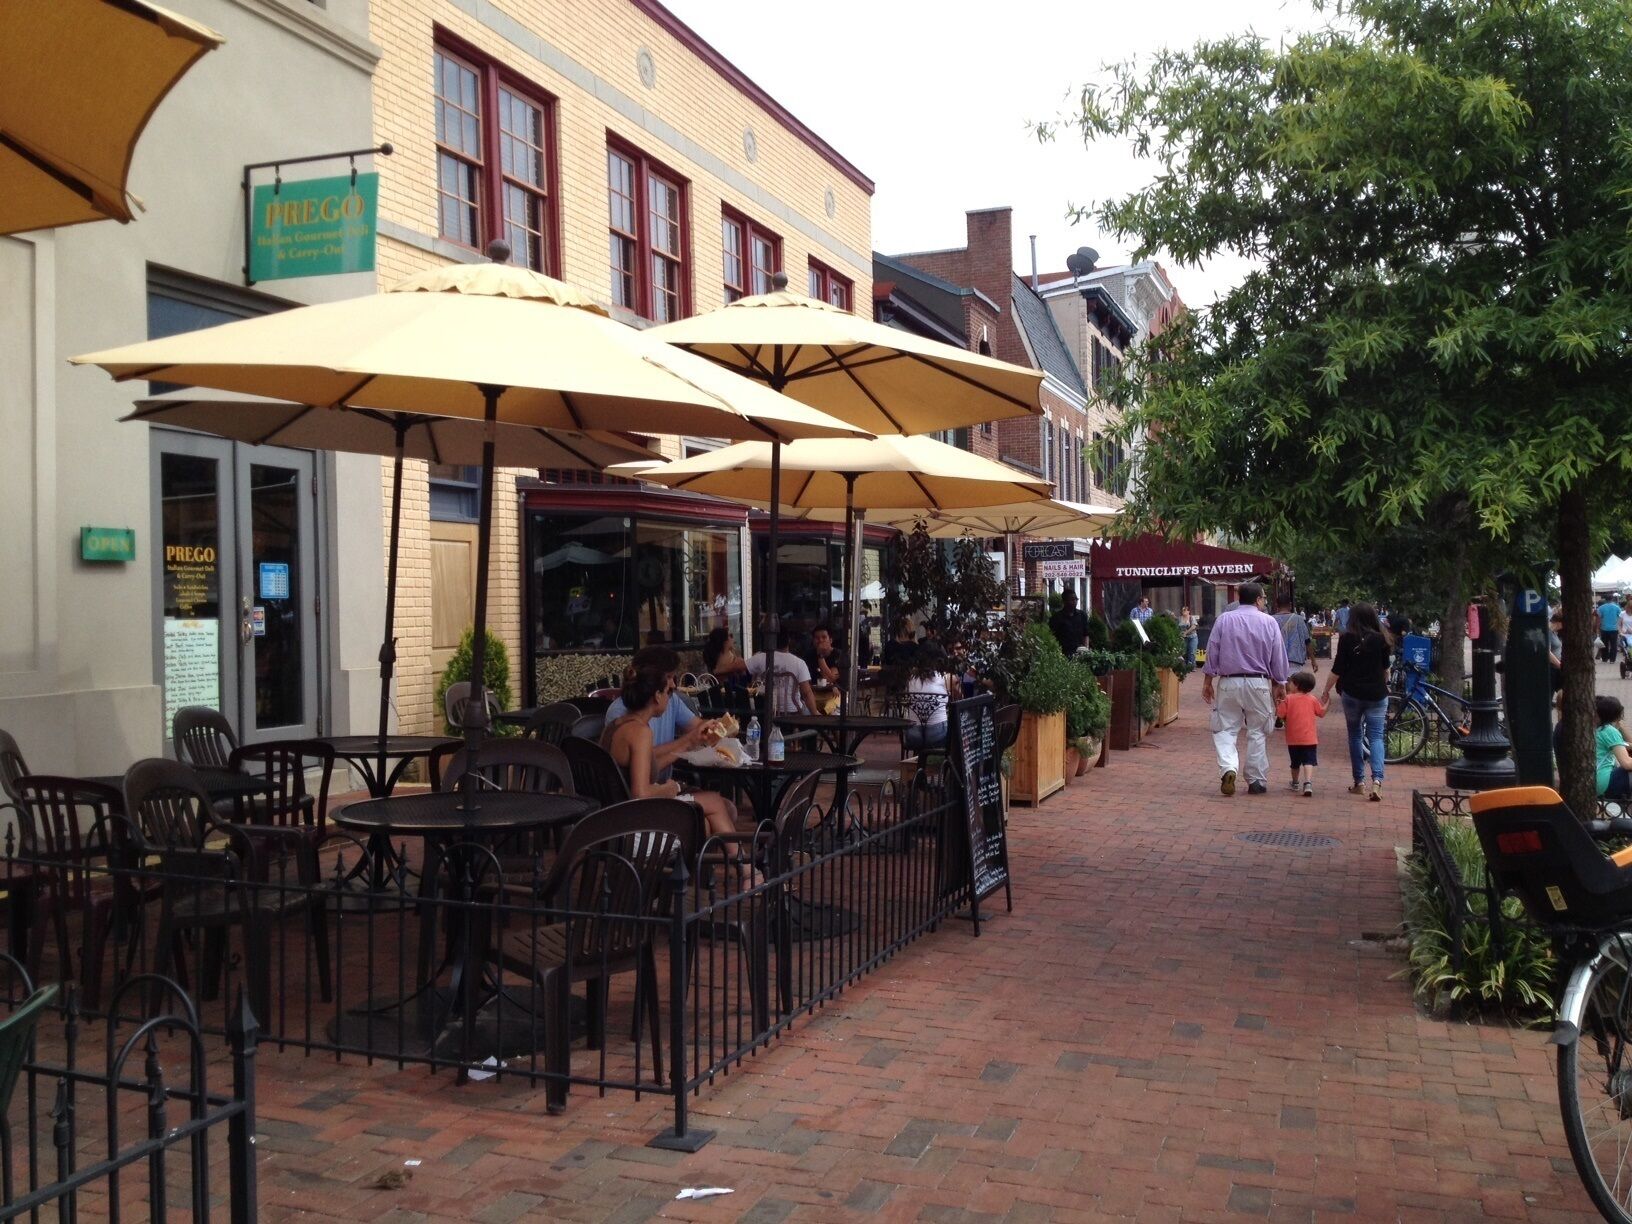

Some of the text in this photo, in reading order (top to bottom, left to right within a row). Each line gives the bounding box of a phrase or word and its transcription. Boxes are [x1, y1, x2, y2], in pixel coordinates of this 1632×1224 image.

[265, 193, 365, 229] PREGO
[257, 233, 292, 247] Italian
[294, 228, 345, 243] Gourmet
[86, 536, 130, 552] OPEN
[166, 546, 215, 562] PREGO
[1116, 563, 1254, 577] TUNNICLIFFS TAVERN
[1525, 589, 1541, 613] P
